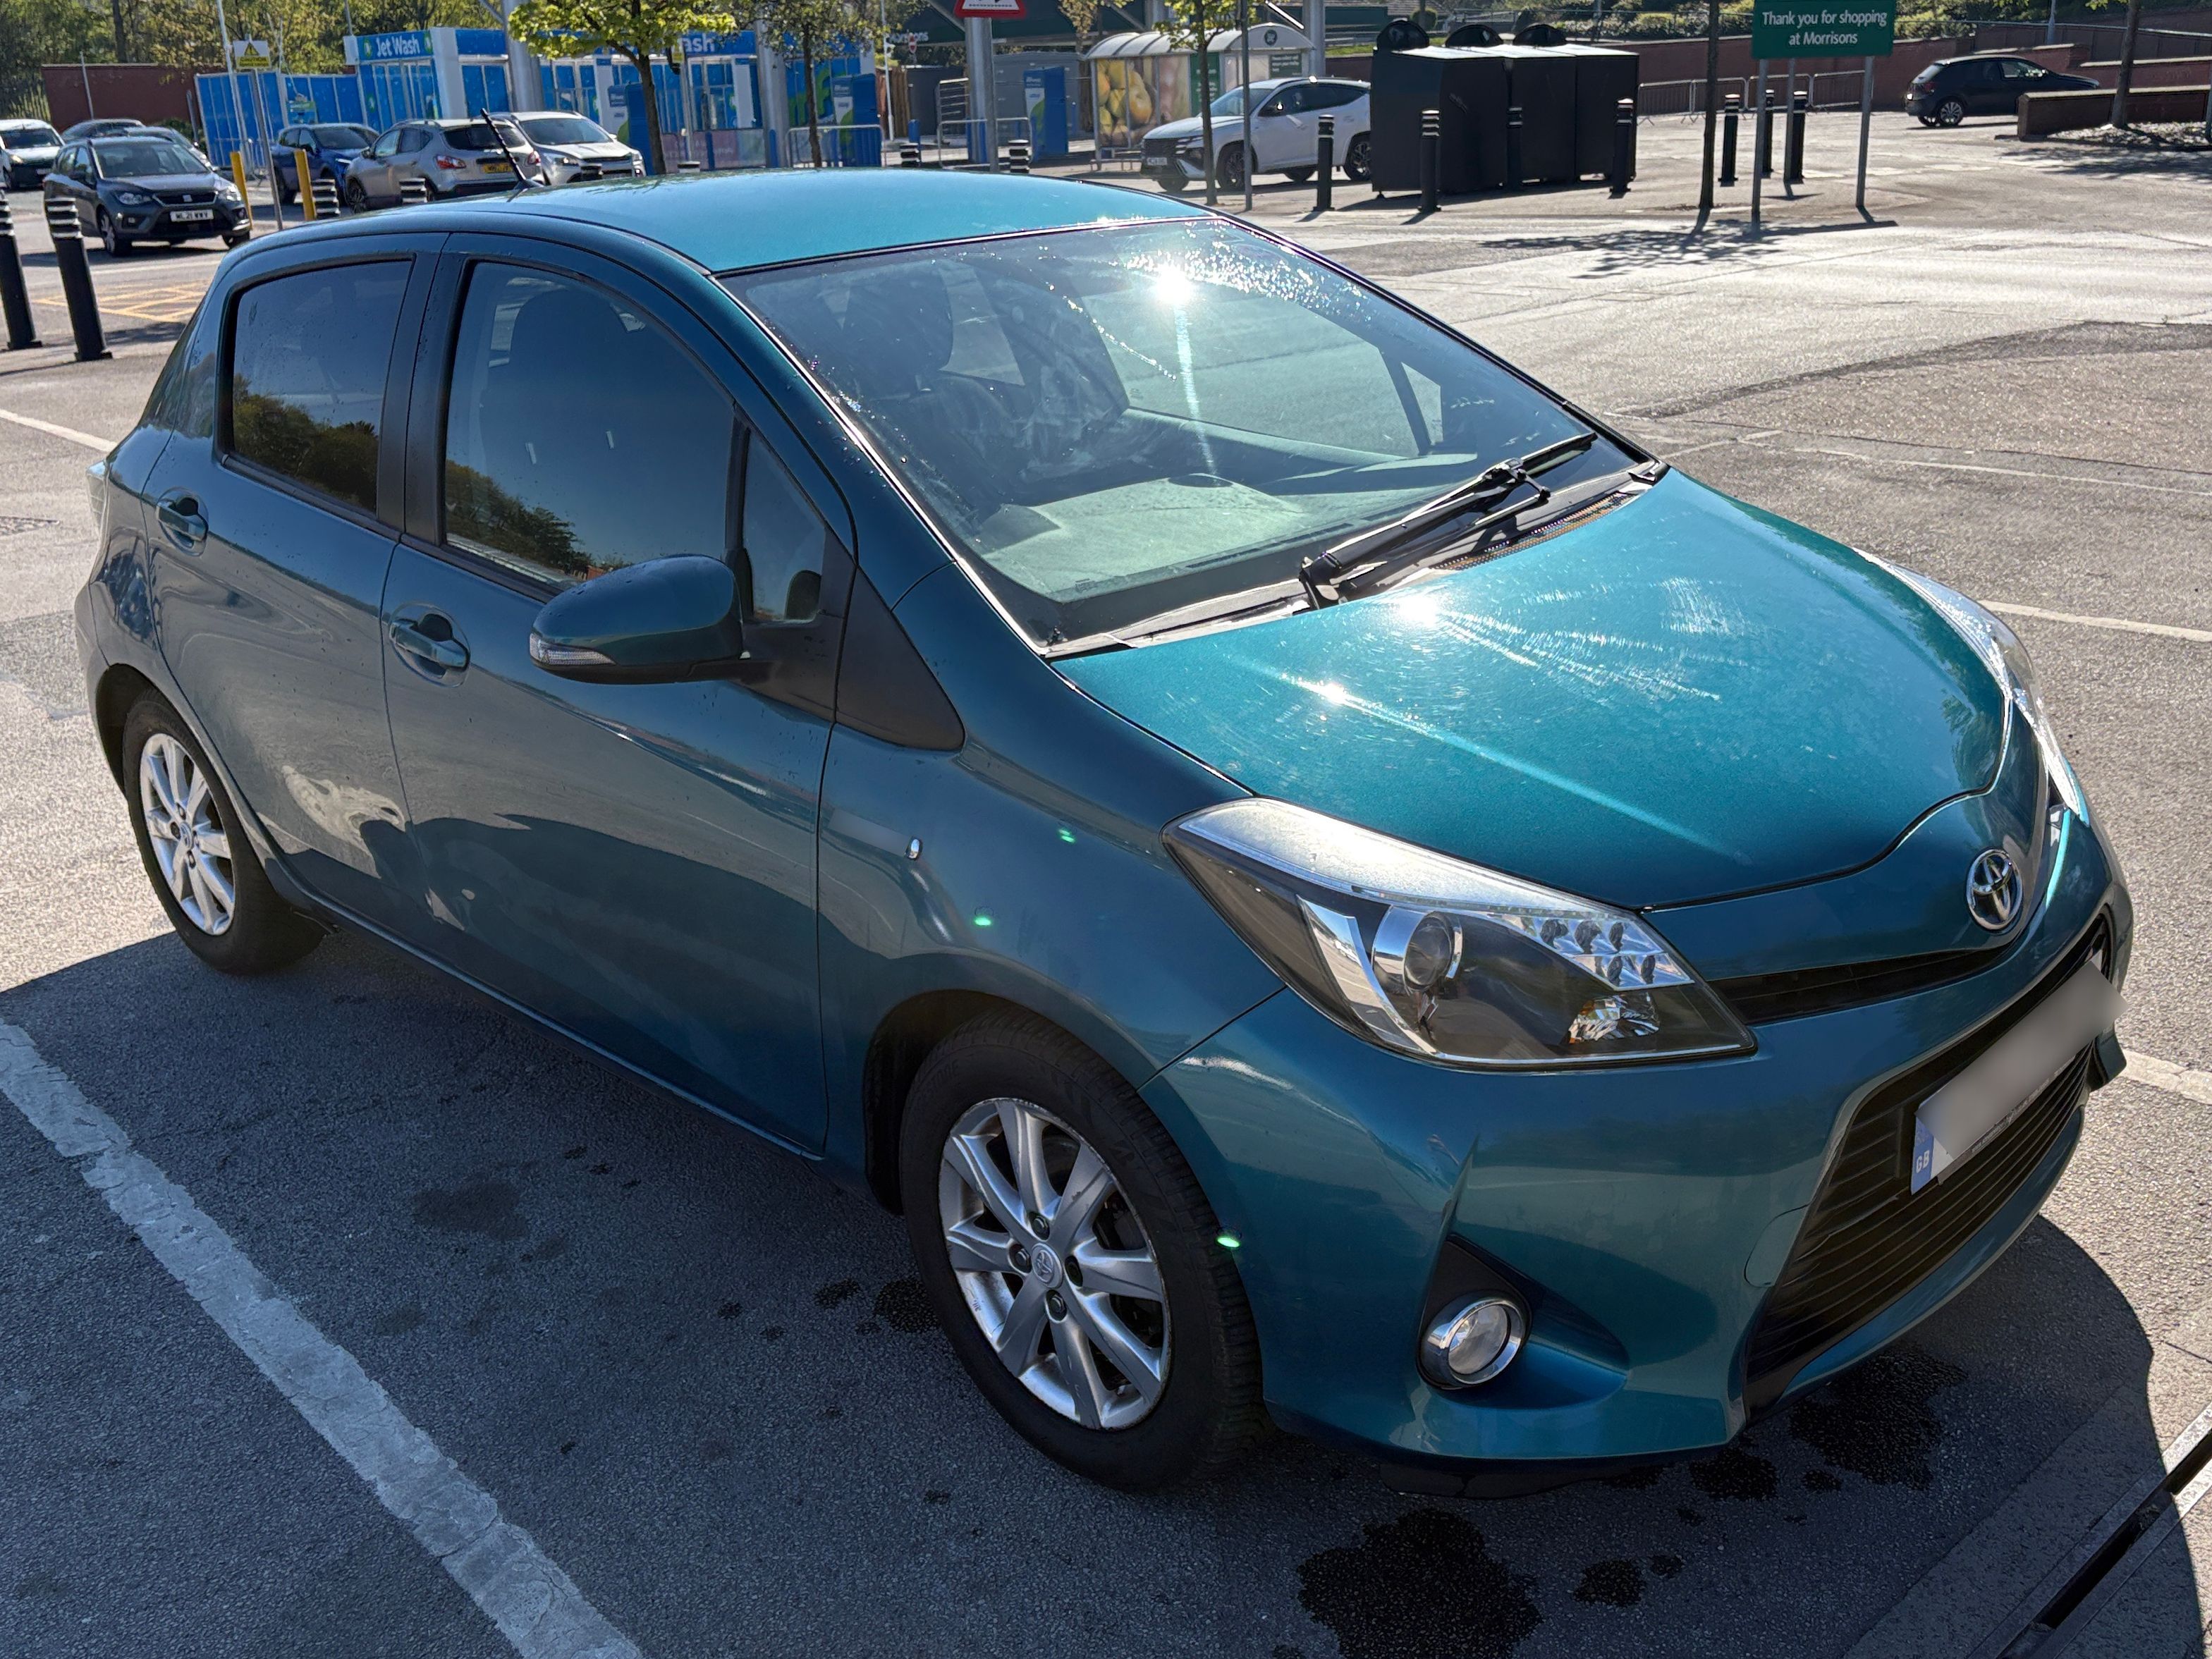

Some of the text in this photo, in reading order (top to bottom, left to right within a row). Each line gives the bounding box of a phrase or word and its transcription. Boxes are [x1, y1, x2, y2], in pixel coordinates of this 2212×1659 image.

[1762, 9, 1888, 29] Thank you for shopping
[376, 34, 420, 58] Jet Wash
[1788, 31, 1858, 46] at Morrisons
[1916, 1149, 1930, 1174] GB
